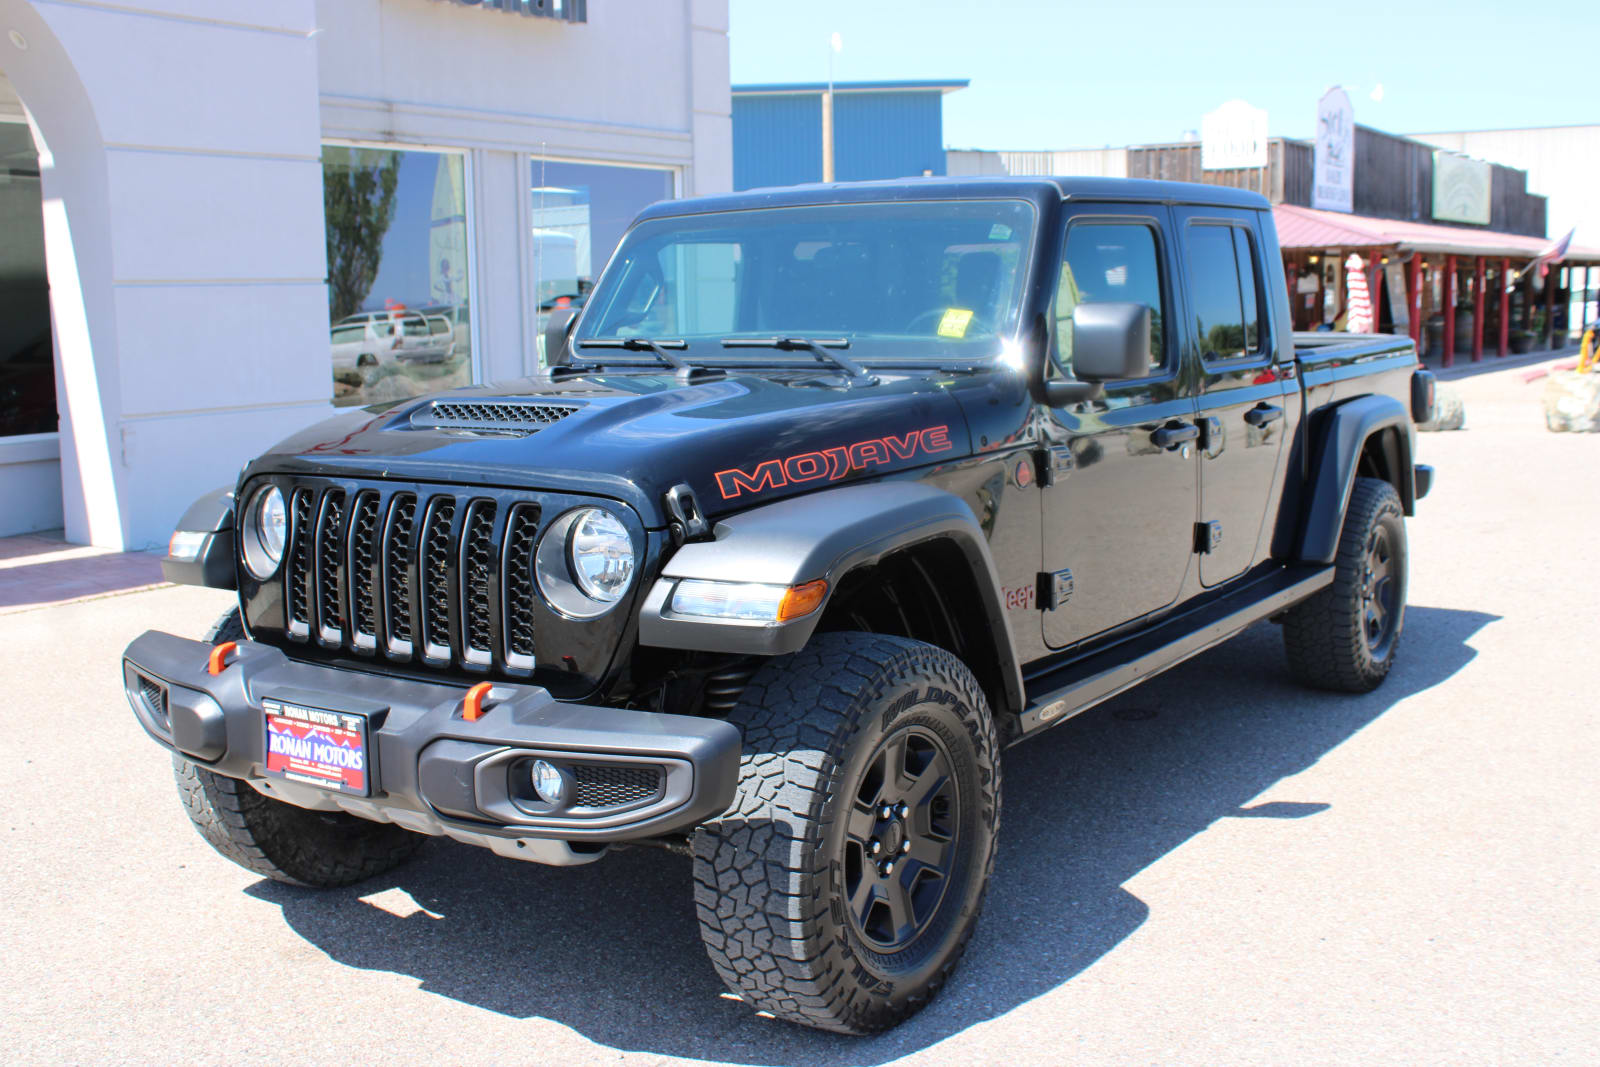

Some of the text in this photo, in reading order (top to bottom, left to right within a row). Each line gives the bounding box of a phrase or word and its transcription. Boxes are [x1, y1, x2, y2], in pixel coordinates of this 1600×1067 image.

[715, 425, 952, 499] MOJAVE
[270, 734, 311, 759] RONAN
[315, 744, 363, 769] MOTORS
